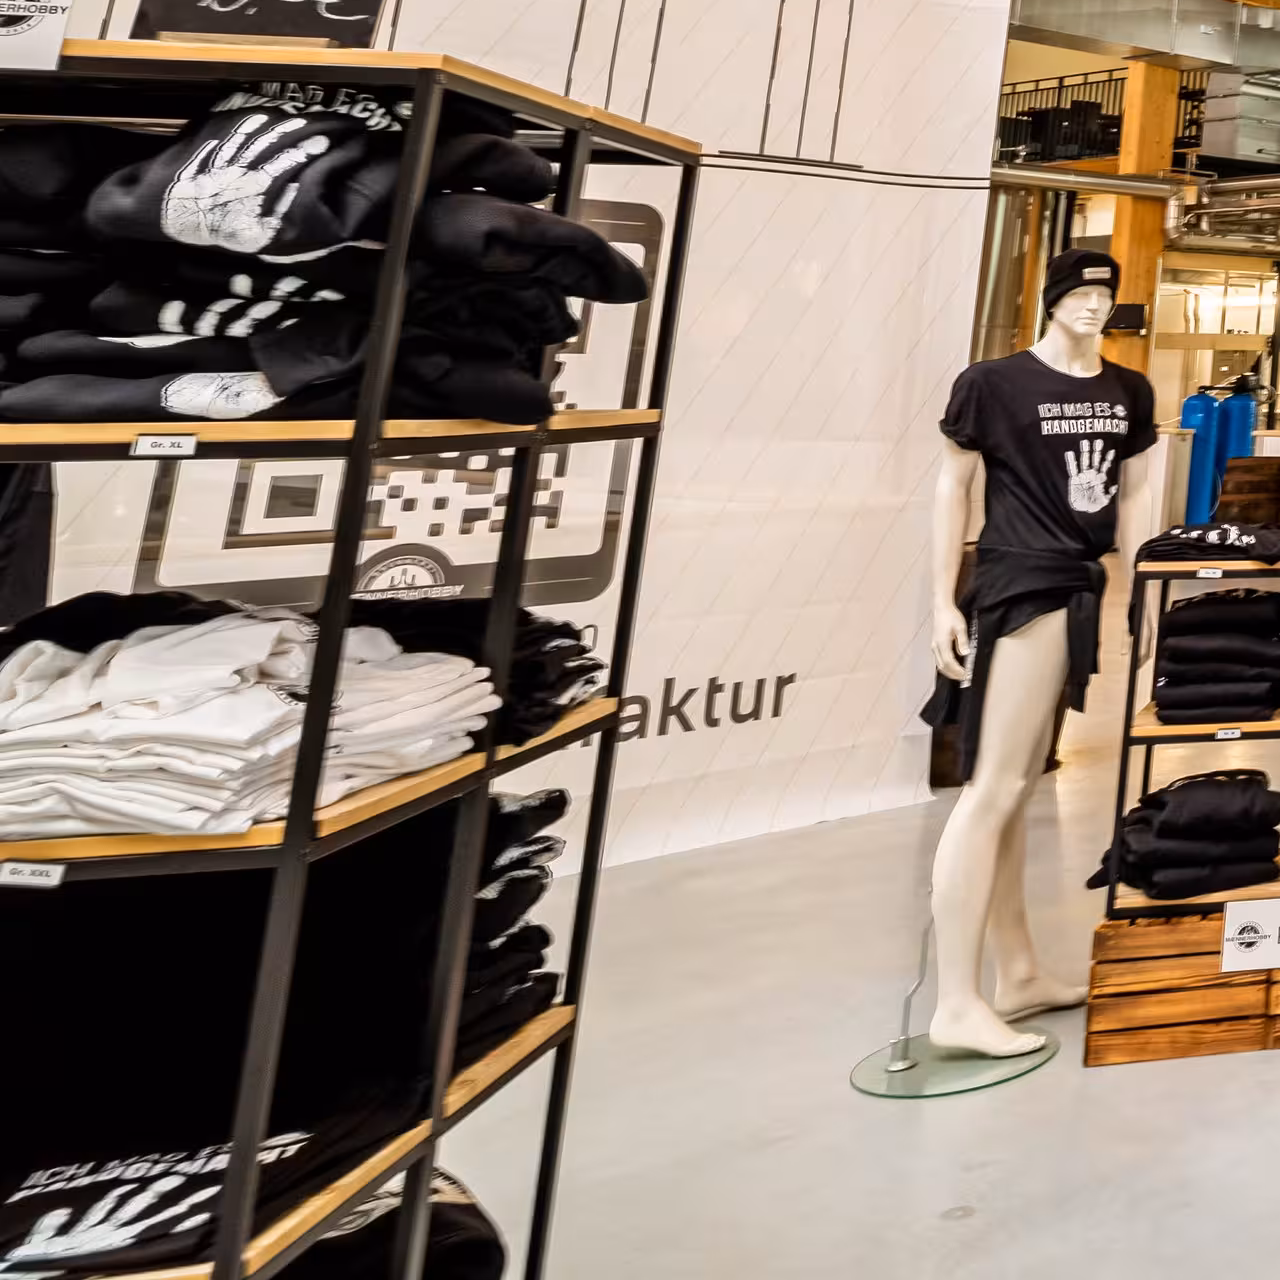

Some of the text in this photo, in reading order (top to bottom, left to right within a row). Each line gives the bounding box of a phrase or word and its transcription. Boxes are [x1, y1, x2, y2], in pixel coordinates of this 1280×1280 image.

[1038, 402, 1112, 417] ICH MAG ES
[150, 441, 183, 449] Gr. XL
[20, 1162, 97, 1188] ICH
